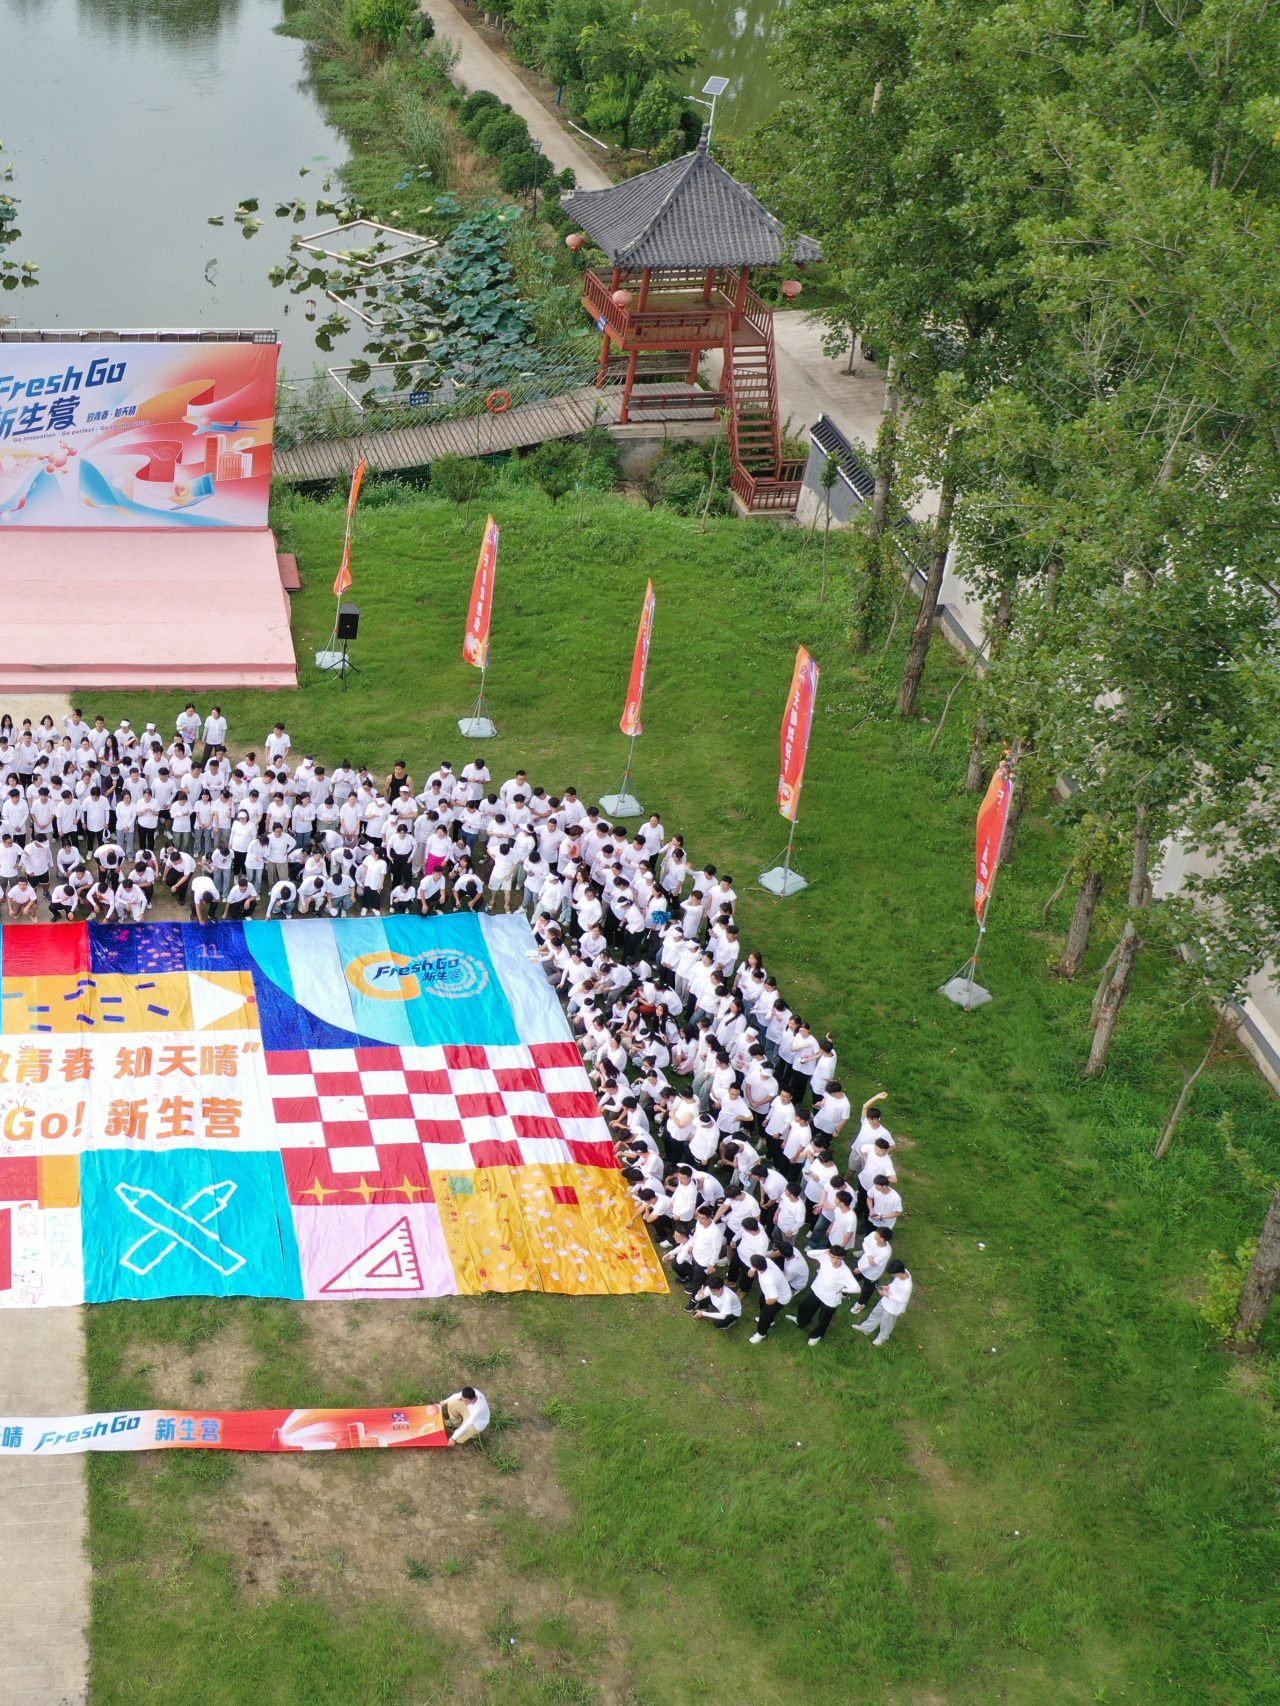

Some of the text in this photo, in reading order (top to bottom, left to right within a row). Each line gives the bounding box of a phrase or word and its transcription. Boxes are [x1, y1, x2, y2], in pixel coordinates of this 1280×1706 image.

[23, 432, 56, 441] innovation
[72, 427, 95, 435] perfect
[3, 1101, 87, 1141] Go!
[104, 1095, 243, 1140] 新生营
[154, 1417, 221, 1442] 新生营
